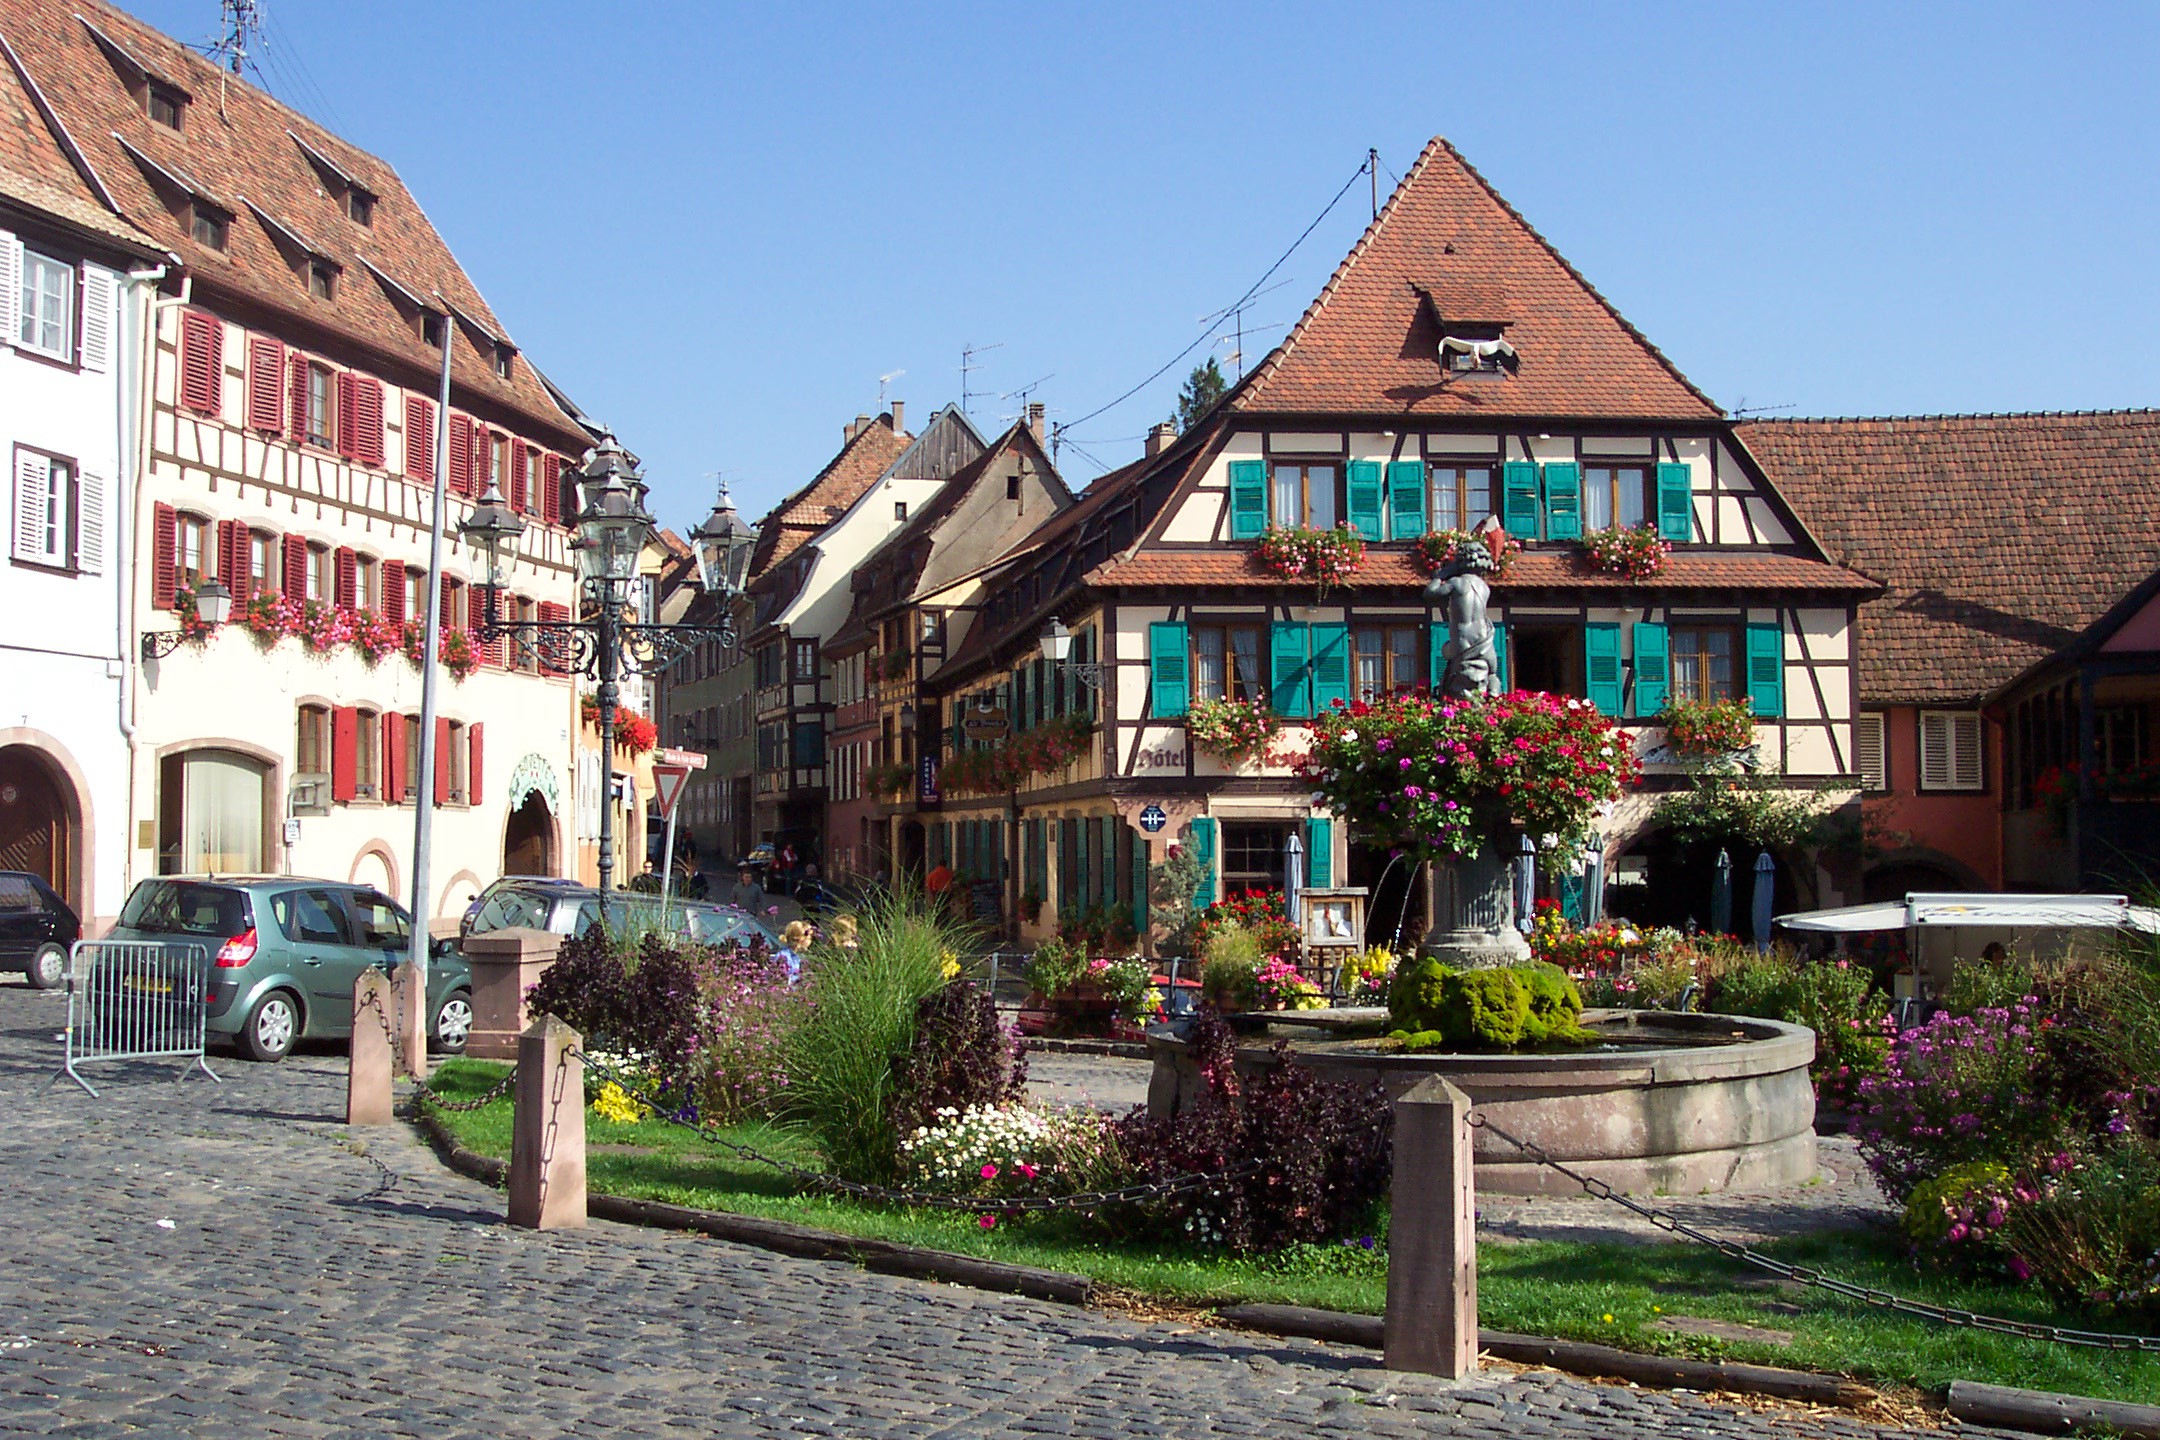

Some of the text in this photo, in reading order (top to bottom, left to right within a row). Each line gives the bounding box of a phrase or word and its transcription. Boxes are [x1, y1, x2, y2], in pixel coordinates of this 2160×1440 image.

[21, 714, 28, 725] 7
[1137, 748, 1185, 769] Hôtel
[1148, 813, 1158, 825] H
